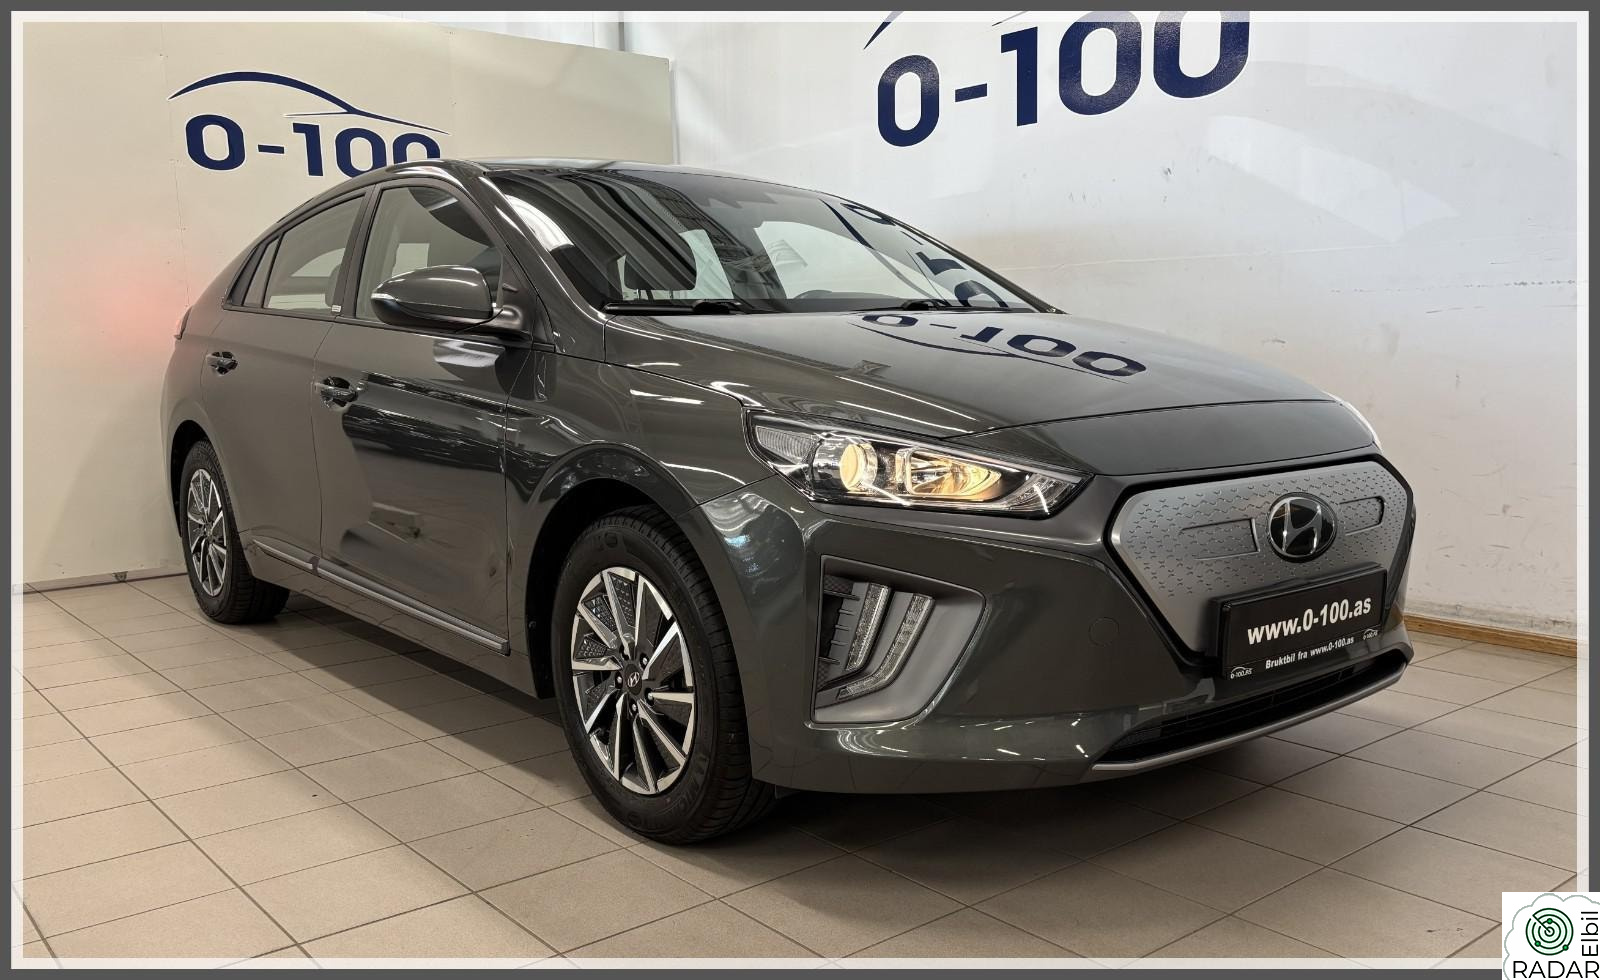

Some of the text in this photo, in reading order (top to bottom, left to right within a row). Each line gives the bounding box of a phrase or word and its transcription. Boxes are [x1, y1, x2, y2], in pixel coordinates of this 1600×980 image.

[878, 11, 1251, 147] 0-100
[1247, 597, 1372, 645] www.0-100.as
[1265, 636, 1355, 669] Bruktbil fra www.0-100.as
